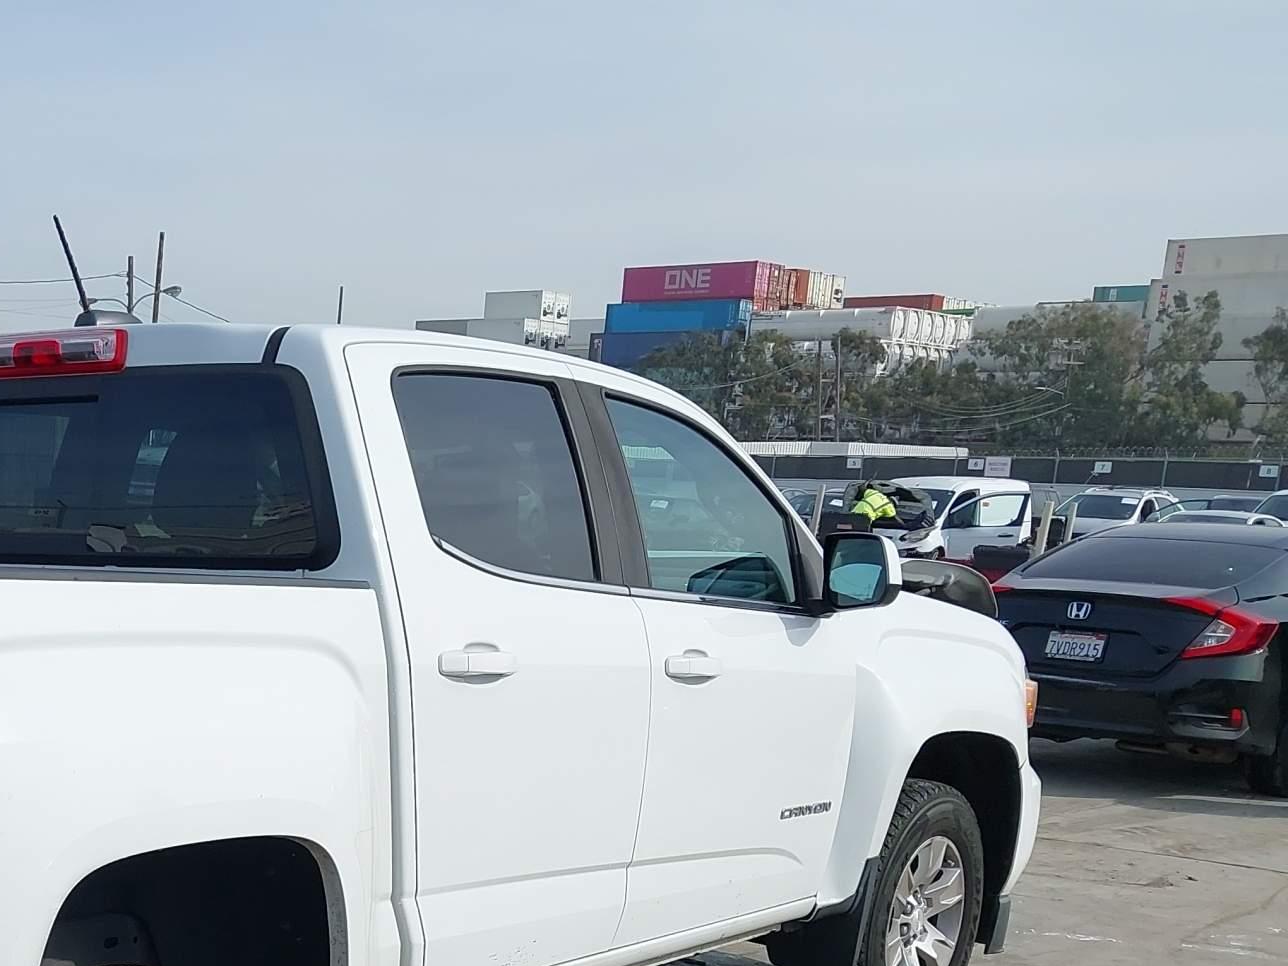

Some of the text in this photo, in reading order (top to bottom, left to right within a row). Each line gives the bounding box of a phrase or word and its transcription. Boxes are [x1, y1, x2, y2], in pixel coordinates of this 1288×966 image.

[664, 268, 712, 290] ONE
[1049, 640, 1101, 658] 7VDR915
[779, 800, 832, 820] CANYON
